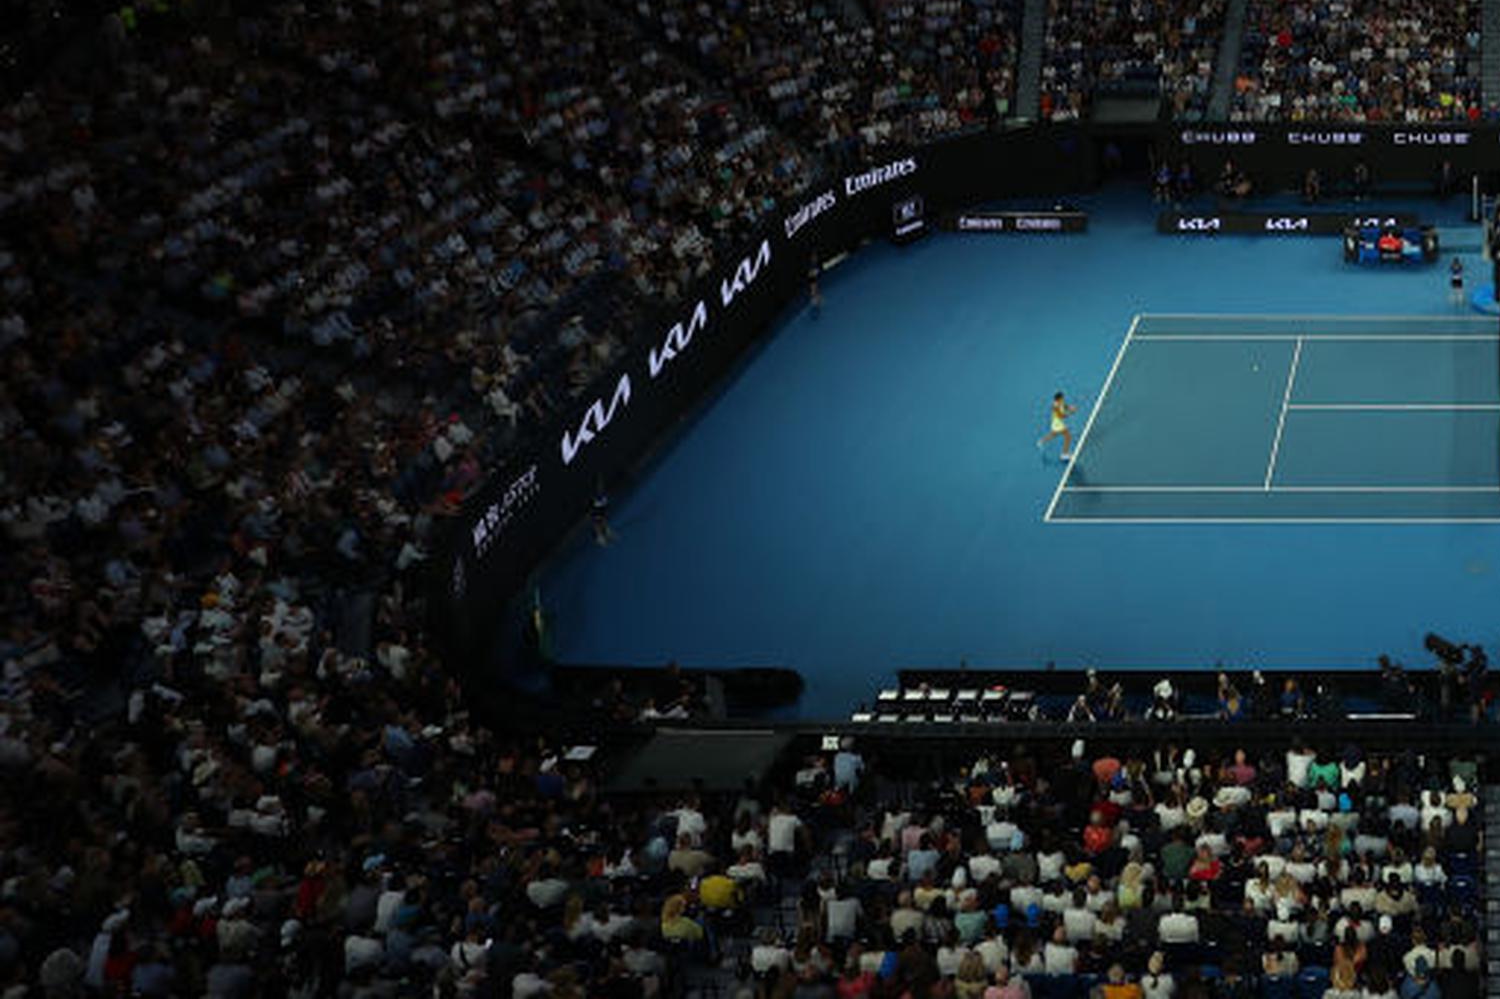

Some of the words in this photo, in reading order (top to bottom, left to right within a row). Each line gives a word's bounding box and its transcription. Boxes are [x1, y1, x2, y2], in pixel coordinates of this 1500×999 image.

[845, 158, 917, 195] Emirates
[1178, 217, 1221, 230] KIA
[1265, 218, 1308, 230] KIA
[720, 239, 771, 306] KIA
[648, 300, 707, 377] KIA
[561, 373, 631, 464] KIA
